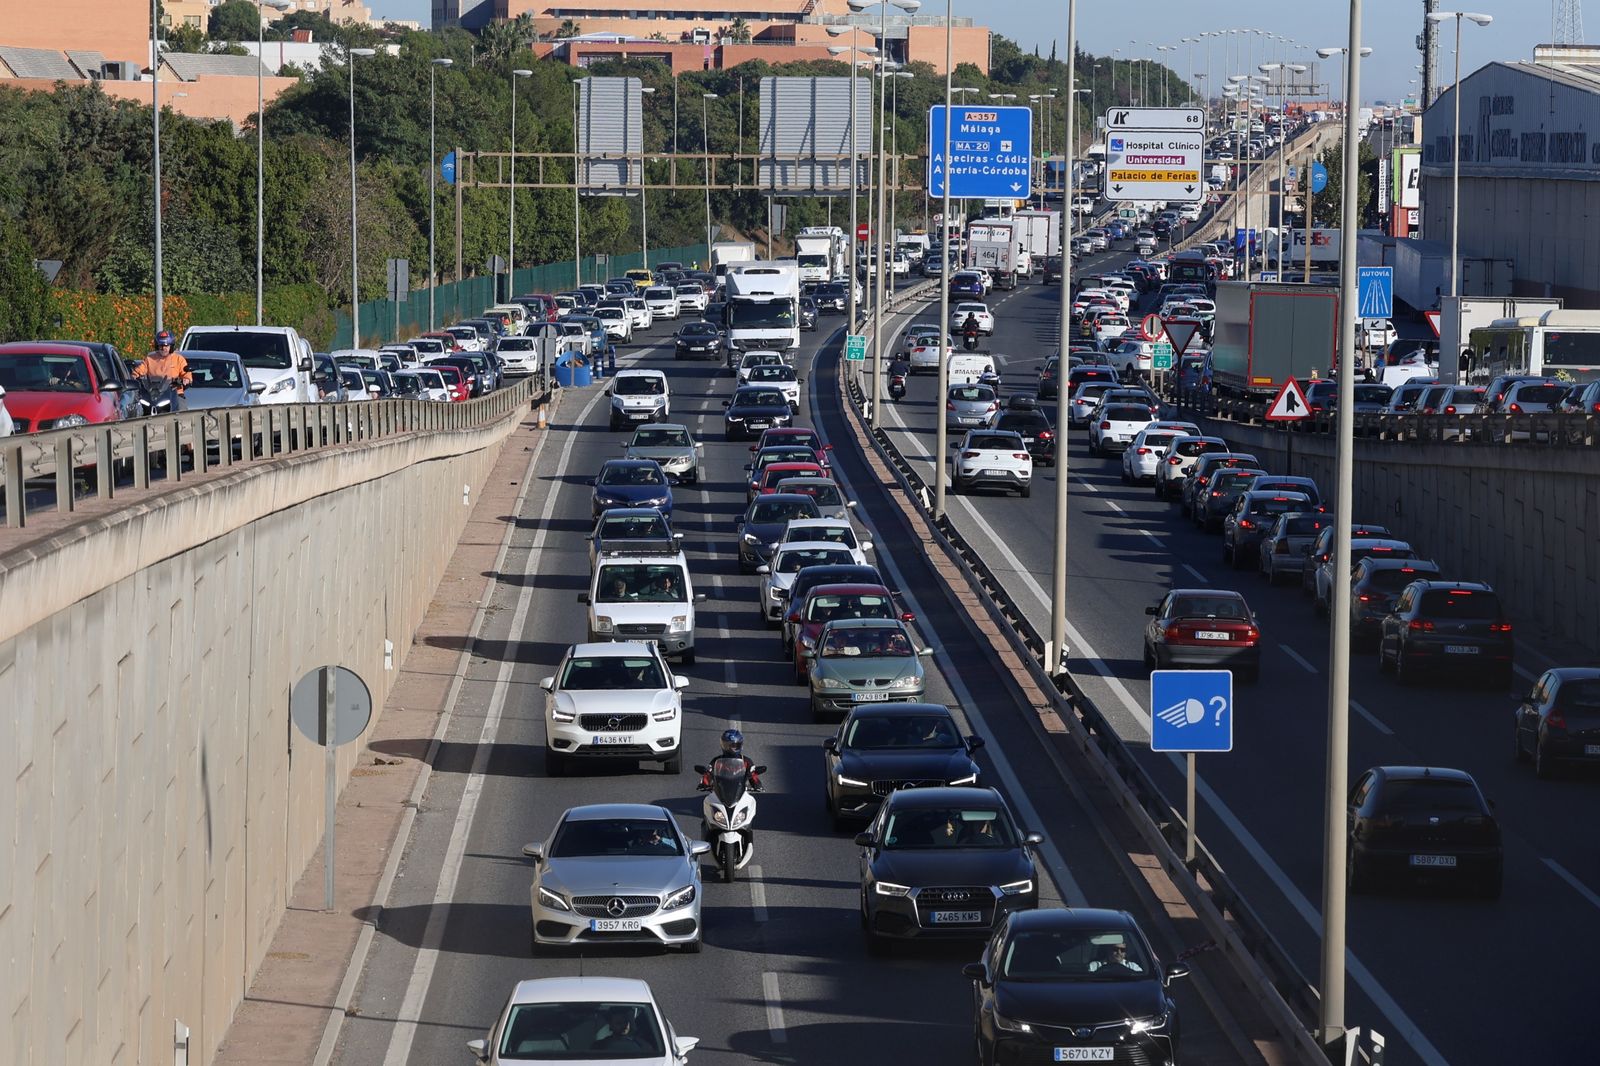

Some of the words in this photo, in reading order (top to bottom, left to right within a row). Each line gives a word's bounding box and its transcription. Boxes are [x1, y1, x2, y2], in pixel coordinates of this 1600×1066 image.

[966, 113, 996, 121] A-357
[1186, 115, 1199, 123] 68
[960, 124, 1001, 135] Málaga
[956, 142, 988, 150] MA-20
[1126, 141, 1164, 151] Hospital
[1168, 142, 1200, 150] Clínico
[996, 154, 1028, 164] Cádiz
[1127, 156, 1182, 164] Universidad
[1111, 172, 1147, 180] Palacio
[1150, 172, 1163, 180] de
[1167, 172, 1197, 180] Ferias
[982, 251, 995, 259] 464
[599, 736, 617, 744] 6436
[618, 735, 632, 743] KVT
[937, 912, 959, 921] 2465
[962, 912, 979, 921] KMS
[597, 920, 620, 930] 3957
[622, 920, 639, 930] KRG
[1062, 1049, 1089, 1060] 5670
[1091, 1048, 1111, 1059] KZY
